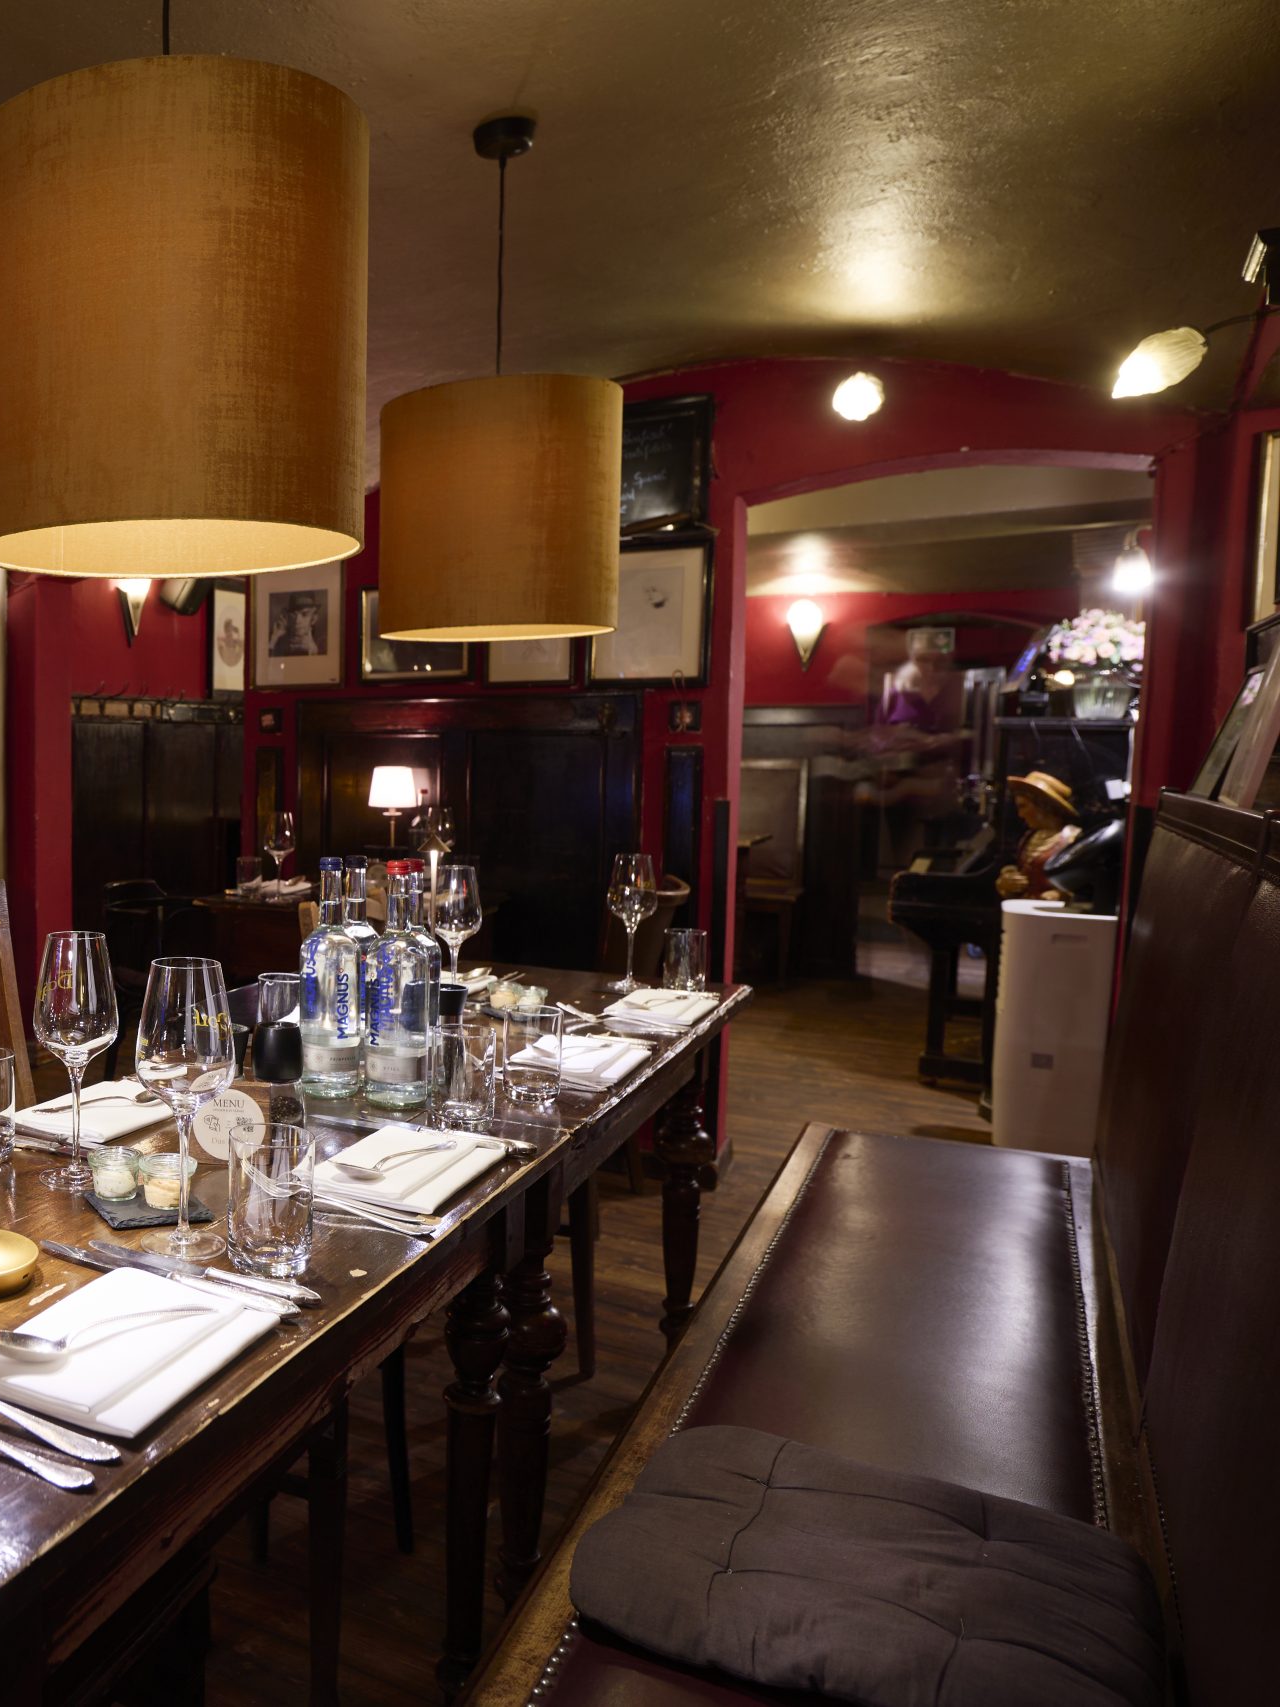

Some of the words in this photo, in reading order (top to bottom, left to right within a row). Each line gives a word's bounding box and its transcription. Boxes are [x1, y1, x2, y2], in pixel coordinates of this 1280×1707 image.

[336, 973, 349, 1039] MAGNUS
[370, 978, 381, 1046] MAGNUS
[213, 1098, 245, 1109] MENU
